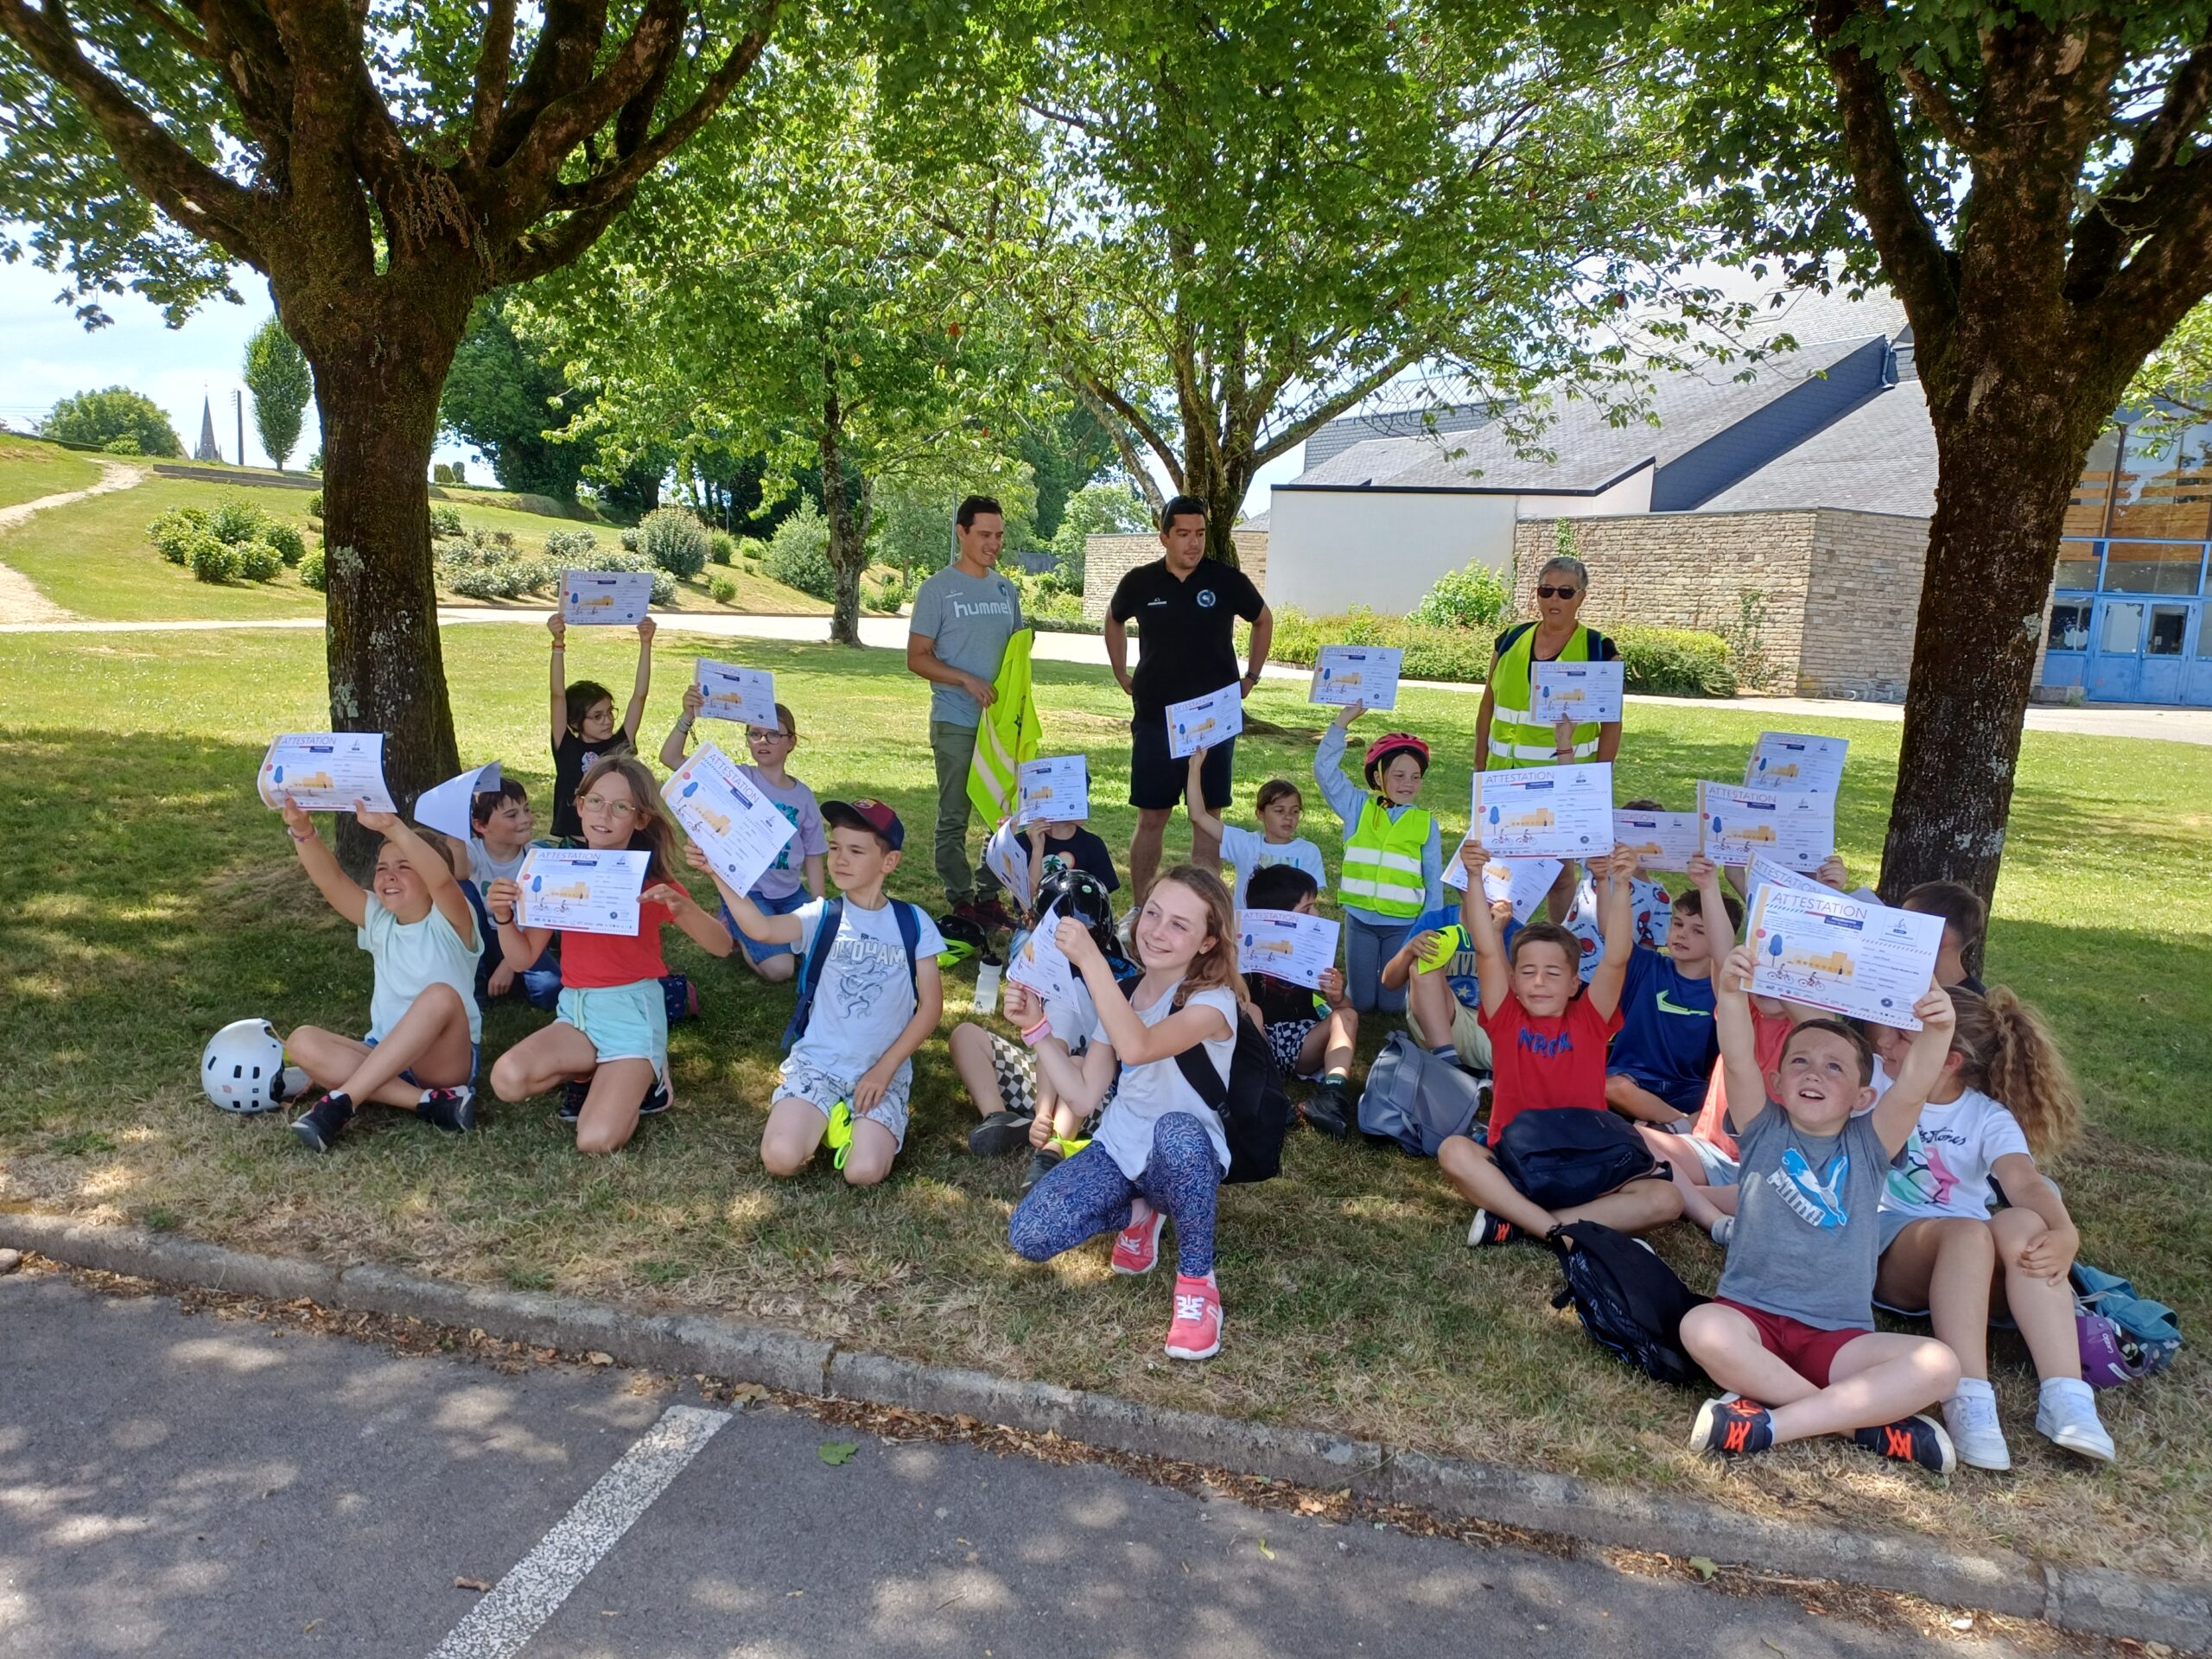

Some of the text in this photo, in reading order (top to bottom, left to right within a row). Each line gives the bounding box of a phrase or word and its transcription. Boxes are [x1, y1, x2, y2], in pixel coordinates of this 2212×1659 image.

[953, 600, 1012, 618] hummel
[282, 736, 337, 745] ATTESTATION
[708, 753, 760, 804] ATTESTATION
[1485, 771, 1555, 785] ATTESTATION
[1708, 785, 1777, 804] ATTESTATION
[538, 851, 602, 861] ATTESTATION
[1771, 892, 1868, 919] ATTESTATION
[1244, 912, 1300, 923] ATTESTATION
[1765, 1166, 1827, 1227] PUMA
